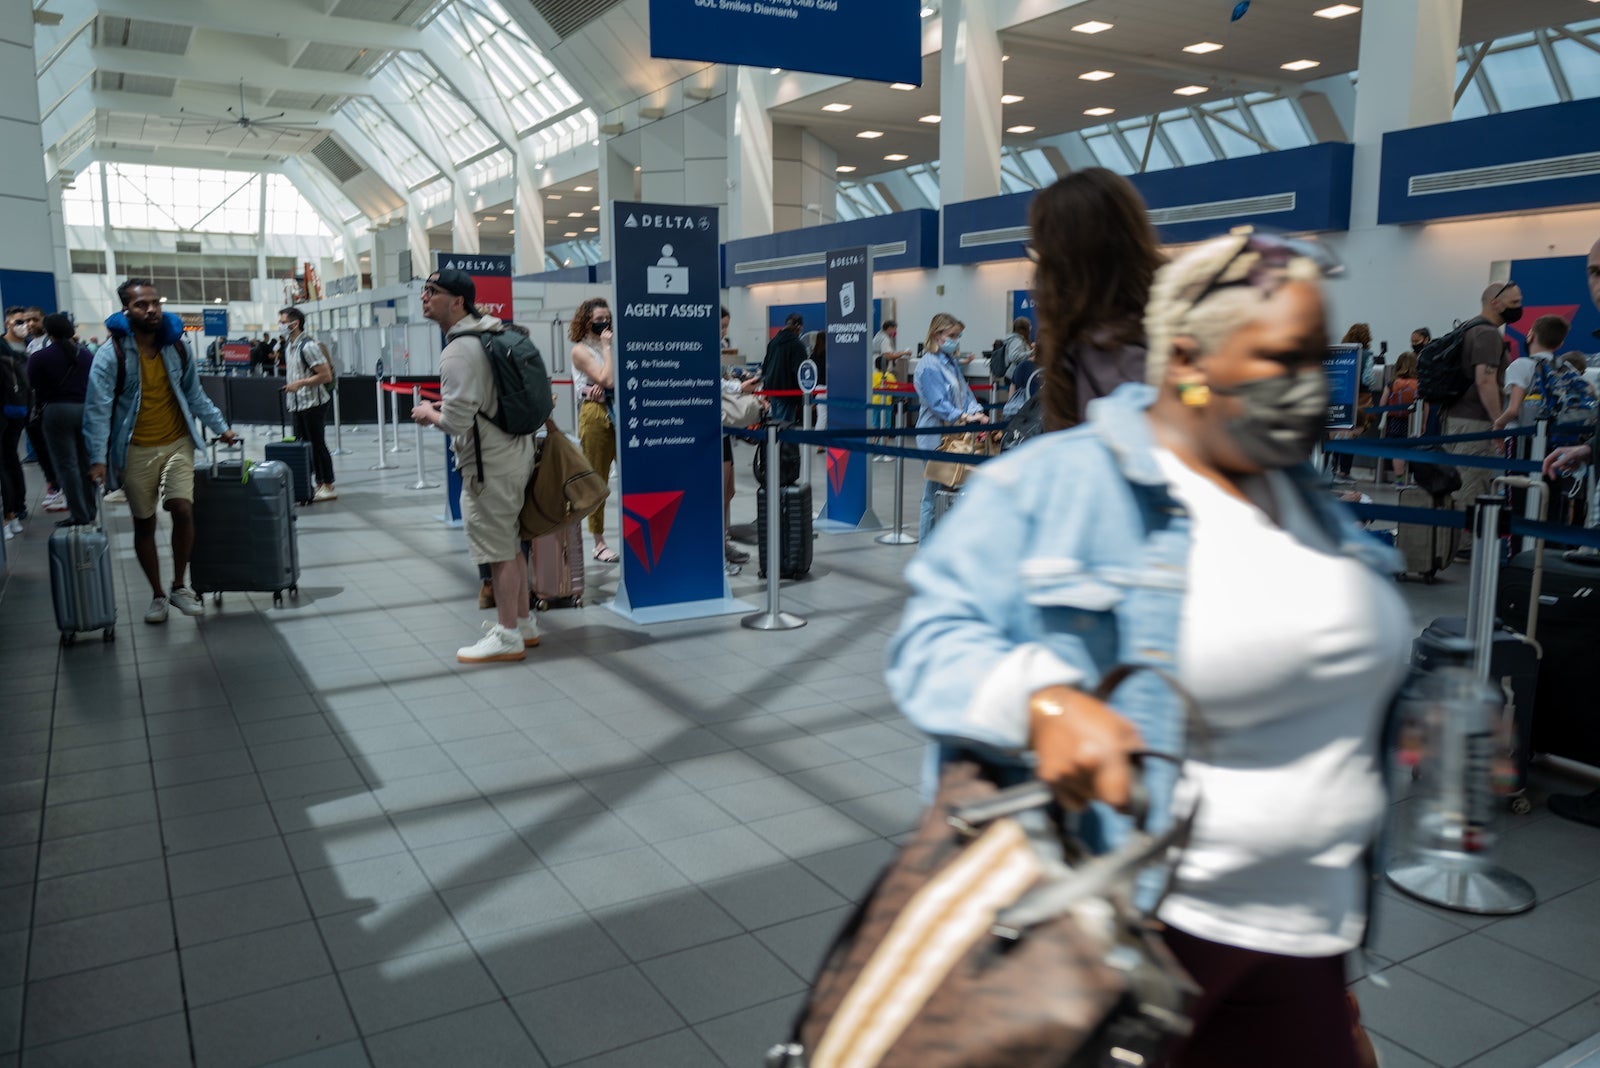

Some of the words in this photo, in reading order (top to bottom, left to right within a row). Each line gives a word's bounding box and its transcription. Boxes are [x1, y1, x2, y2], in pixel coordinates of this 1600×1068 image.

[719, 0, 751, 13] Smiles
[753, 3, 798, 19] Diamante
[815, 1, 838, 11] Gold
[641, 214, 694, 229] DELTA
[457, 260, 495, 271] DELTA
[836, 256, 859, 266] DELTA
[624, 303, 668, 317] AGENT
[670, 304, 714, 317] ASSIST
[828, 322, 867, 333] INTERNATIONAL
[626, 341, 664, 351] SERVICES
[641, 379, 669, 388] Checked
[669, 378, 696, 388] Specialty
[697, 378, 714, 387] Items
[642, 397, 691, 408] Unaccompanied
[691, 397, 713, 406] Minors
[643, 437, 662, 447] Agent
[662, 436, 696, 445] Assistance
